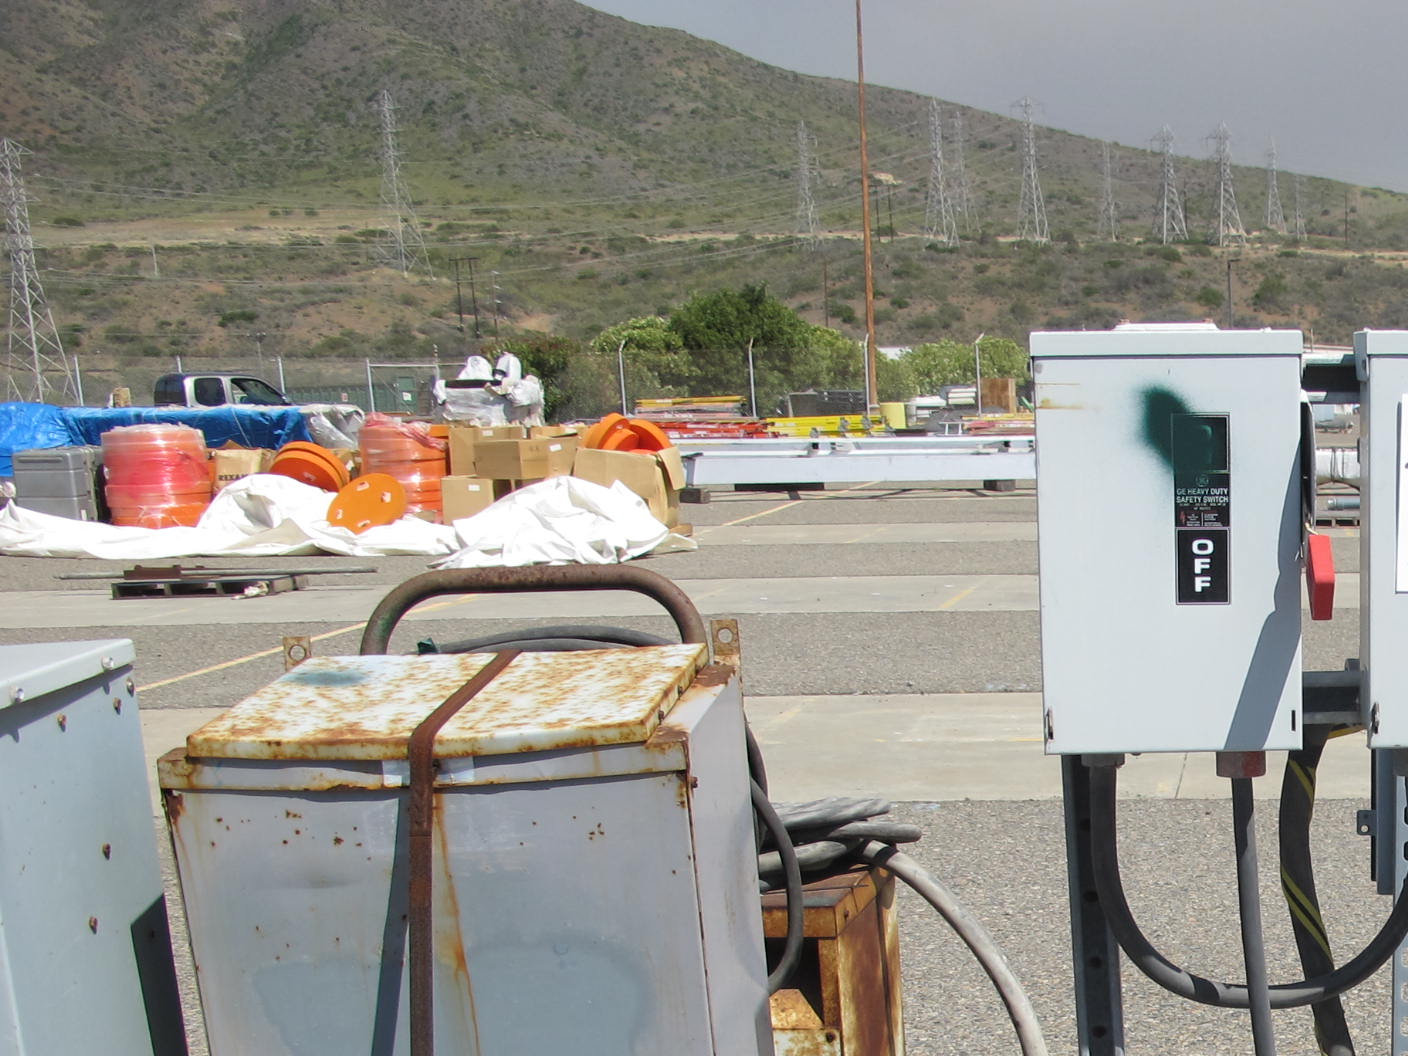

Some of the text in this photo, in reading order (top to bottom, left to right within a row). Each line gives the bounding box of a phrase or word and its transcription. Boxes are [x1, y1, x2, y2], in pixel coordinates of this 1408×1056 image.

[1187, 488, 1209, 496] HEAVY
[1210, 488, 1228, 496] DUTY
[1176, 496, 1229, 504] SAFETY SWITCH
[1192, 538, 1215, 593] OFF
